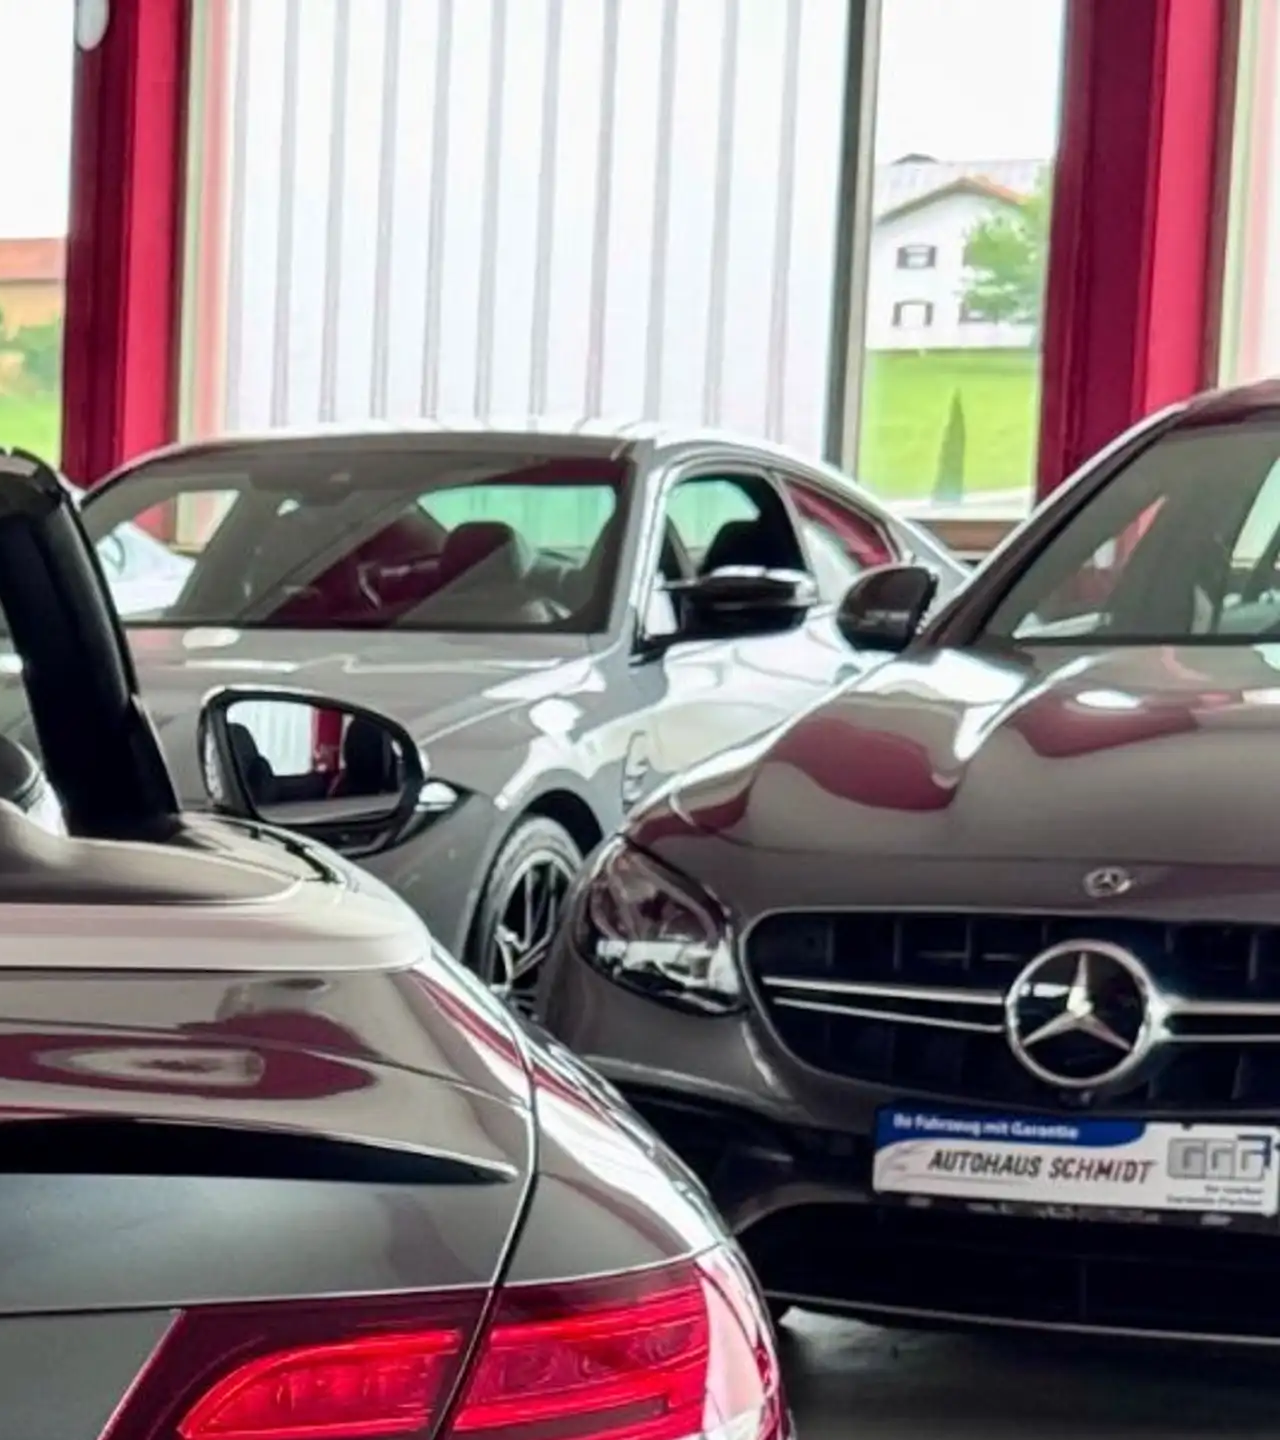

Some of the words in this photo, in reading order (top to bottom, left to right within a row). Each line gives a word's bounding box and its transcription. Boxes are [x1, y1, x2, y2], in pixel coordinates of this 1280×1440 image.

[1010, 1121, 1080, 1140] Garantie
[928, 1149, 1042, 1178] AUTOHAUS
[1048, 1156, 1156, 1184] SCHMIDT
